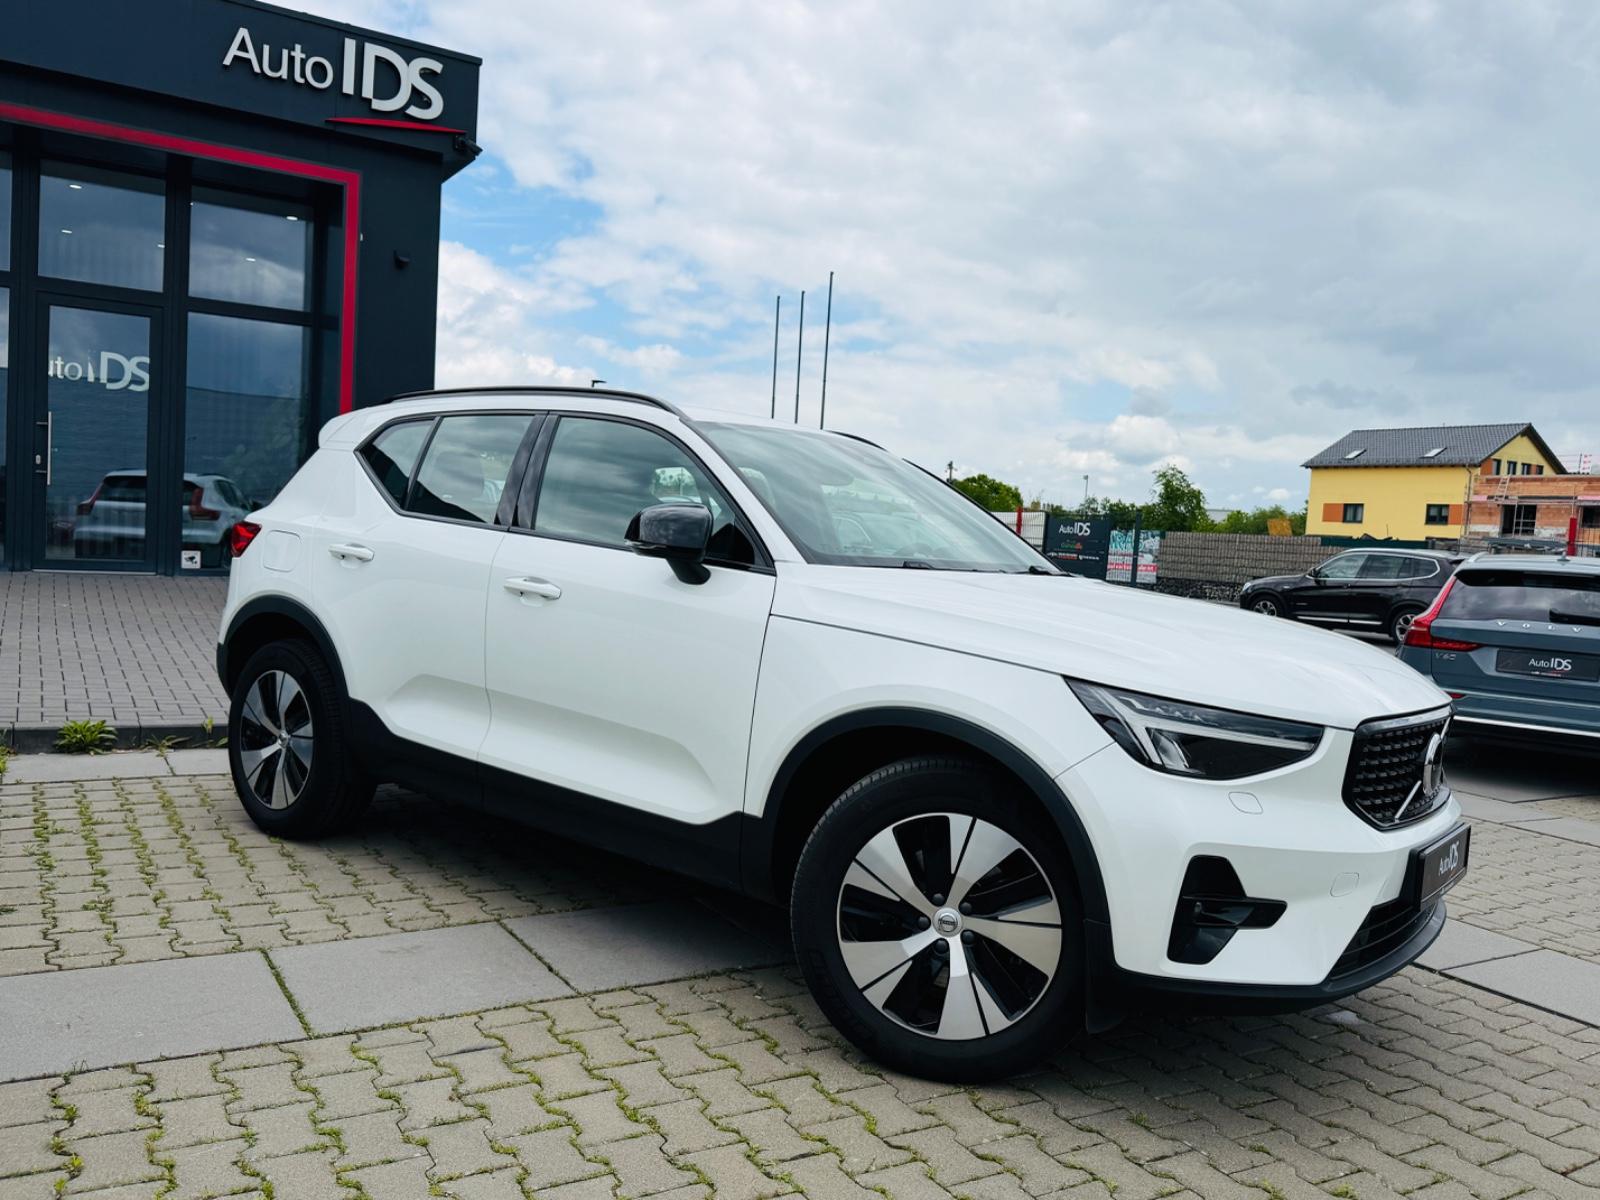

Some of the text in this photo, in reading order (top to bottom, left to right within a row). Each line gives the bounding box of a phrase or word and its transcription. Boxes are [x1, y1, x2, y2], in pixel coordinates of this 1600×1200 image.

[222, 27, 444, 121] Auto IDS
[1074, 522, 1091, 536] IDS
[1528, 657, 1572, 671] Auto IDS
